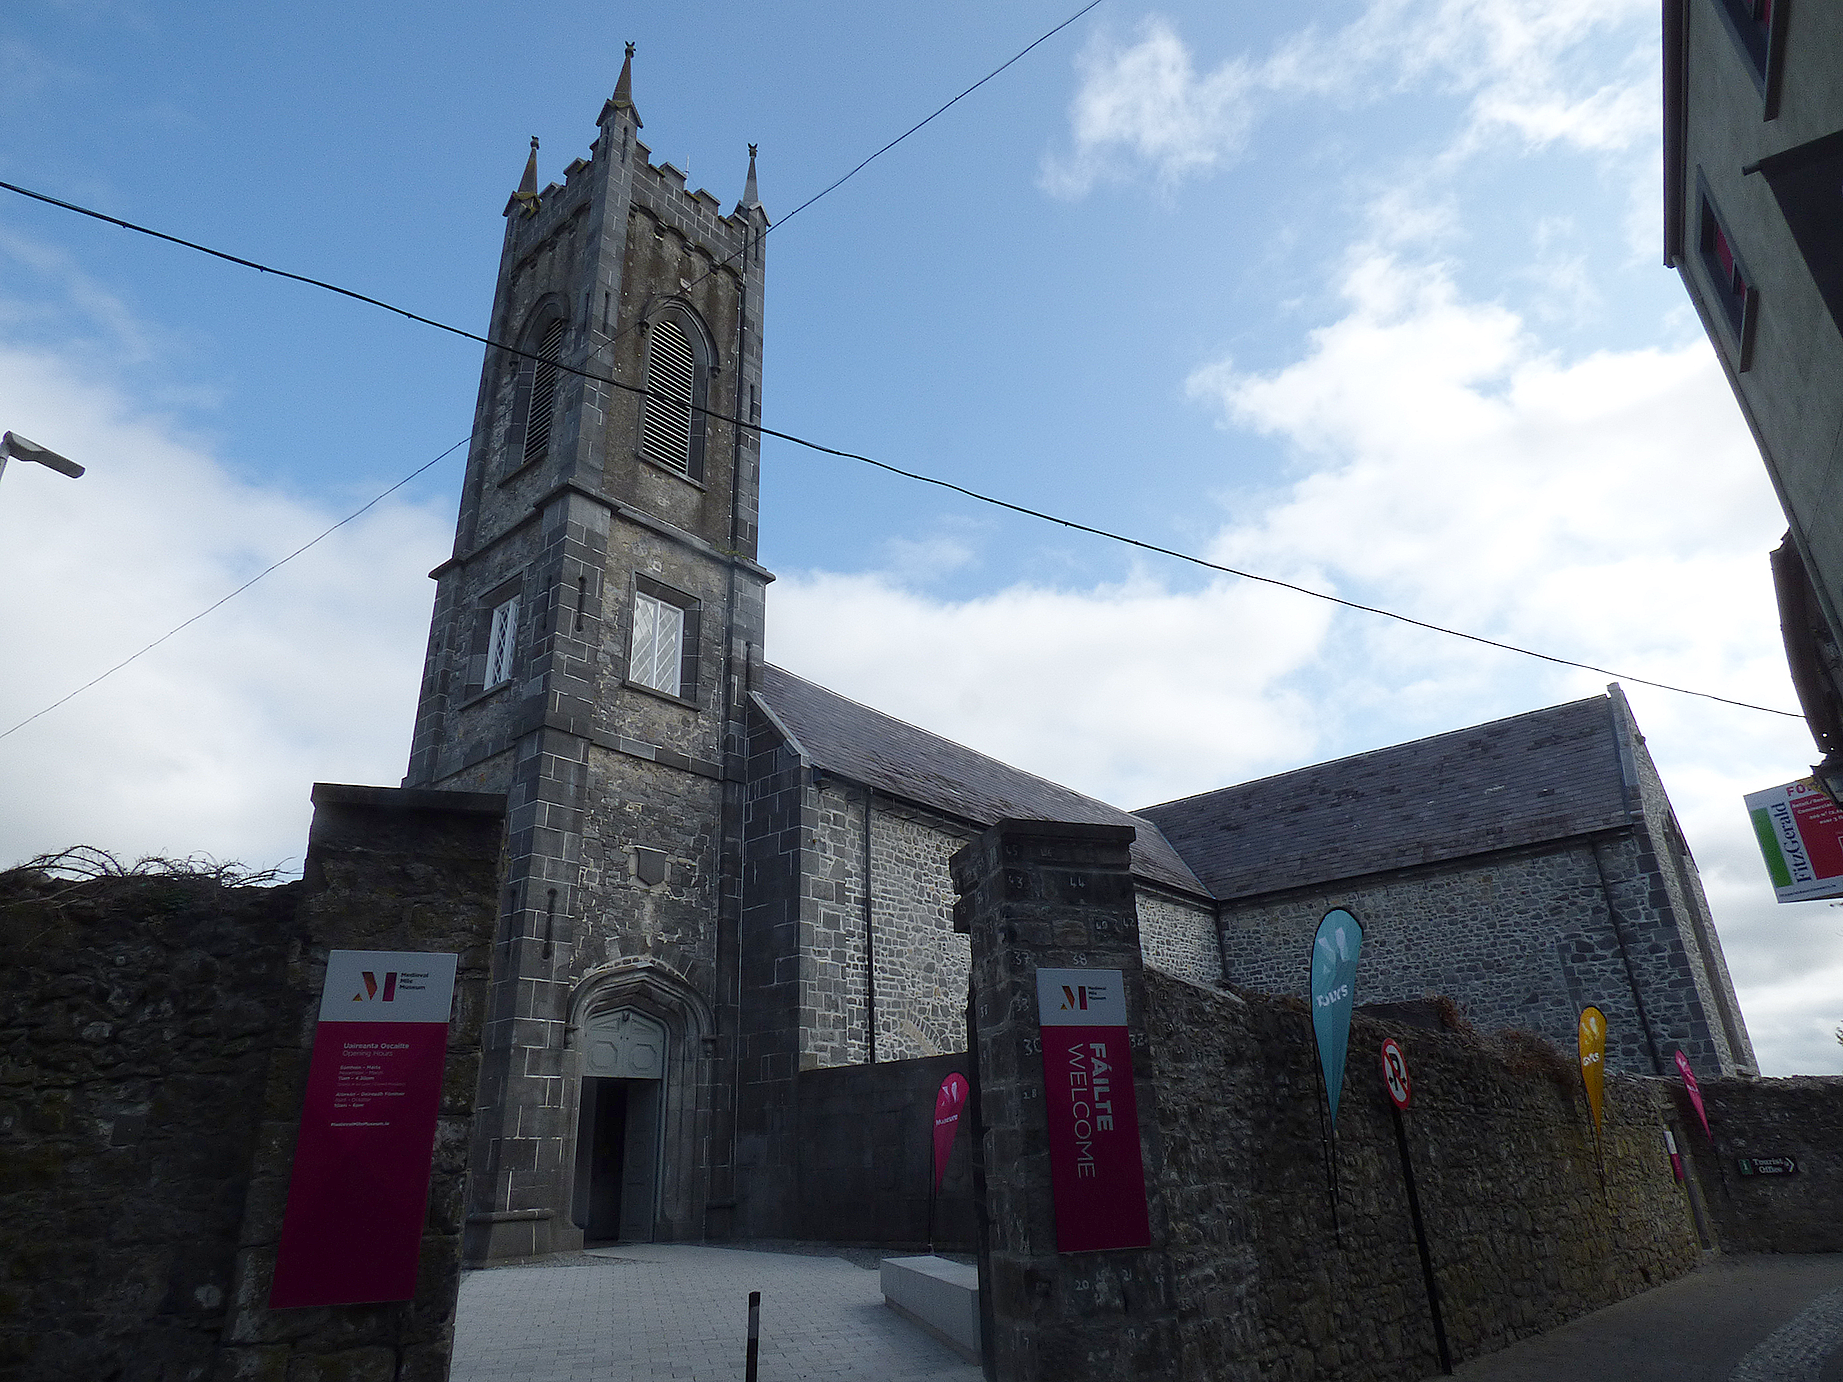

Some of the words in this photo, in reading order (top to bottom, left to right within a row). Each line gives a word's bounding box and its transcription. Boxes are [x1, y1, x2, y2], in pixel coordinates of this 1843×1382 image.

[1786, 783, 1812, 797] FO
[1069, 876, 1085, 888] 44
[1089, 1042, 1113, 1132] FÁILTE
[1068, 1043, 1096, 1179] WELCOME
[1752, 1157, 1784, 1166] Tourist
[1759, 1165, 1783, 1174] Office
